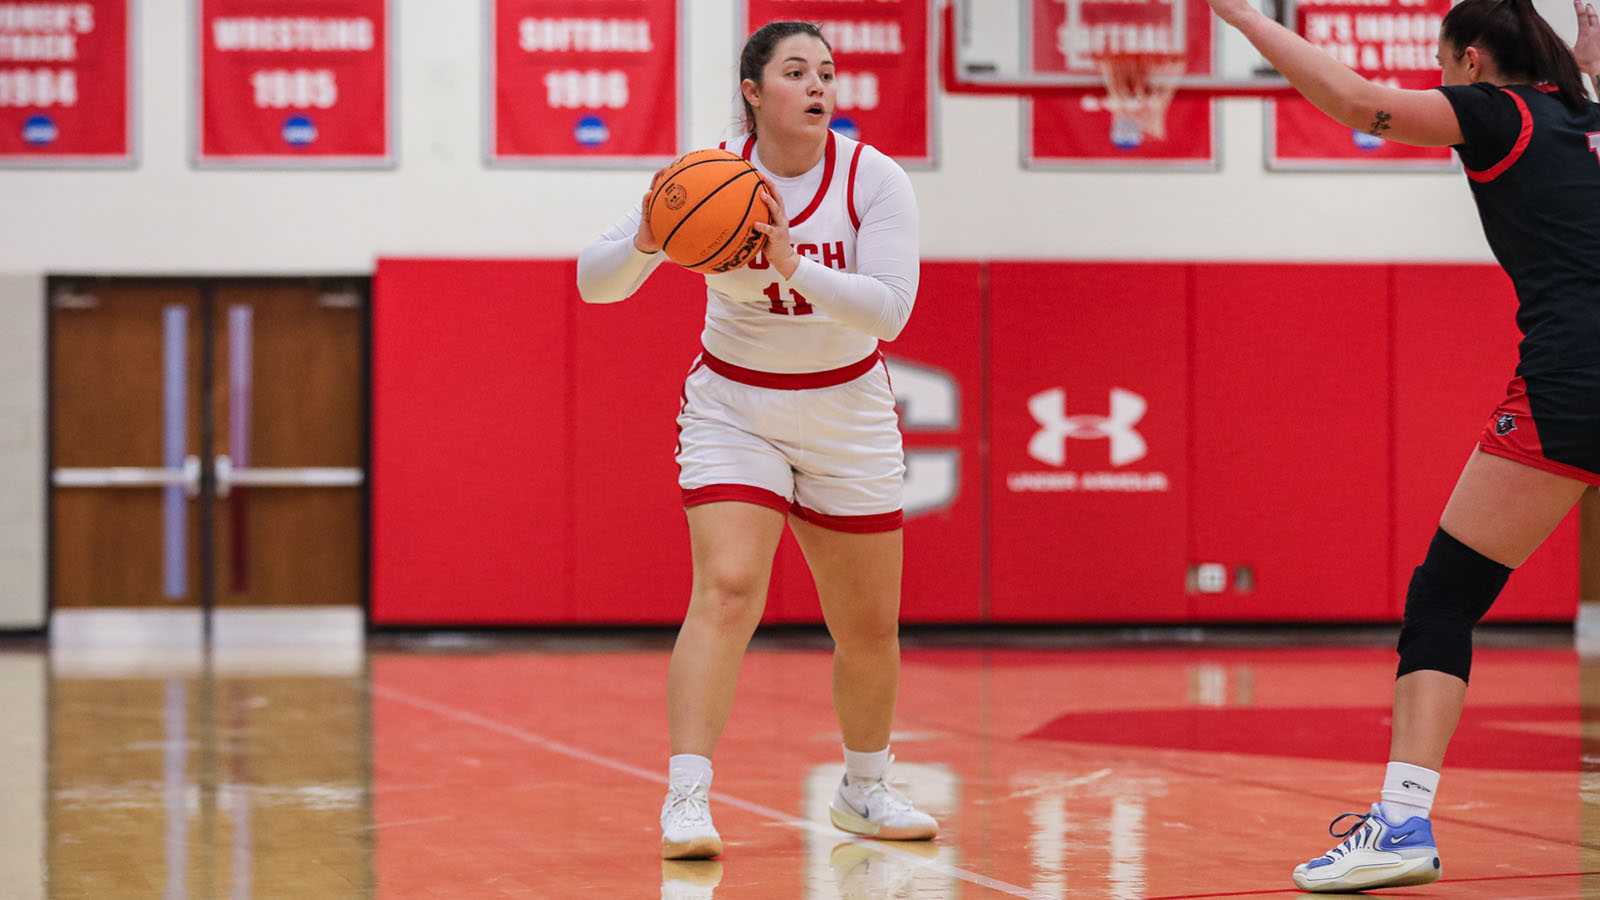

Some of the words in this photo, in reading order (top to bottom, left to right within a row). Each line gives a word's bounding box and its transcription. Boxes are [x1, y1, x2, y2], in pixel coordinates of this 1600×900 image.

[213, 18, 374, 50] WRESTLING
[519, 17, 653, 52] SOFTBALL
[712, 227, 762, 272] NCAA
[763, 282, 813, 316] 11
